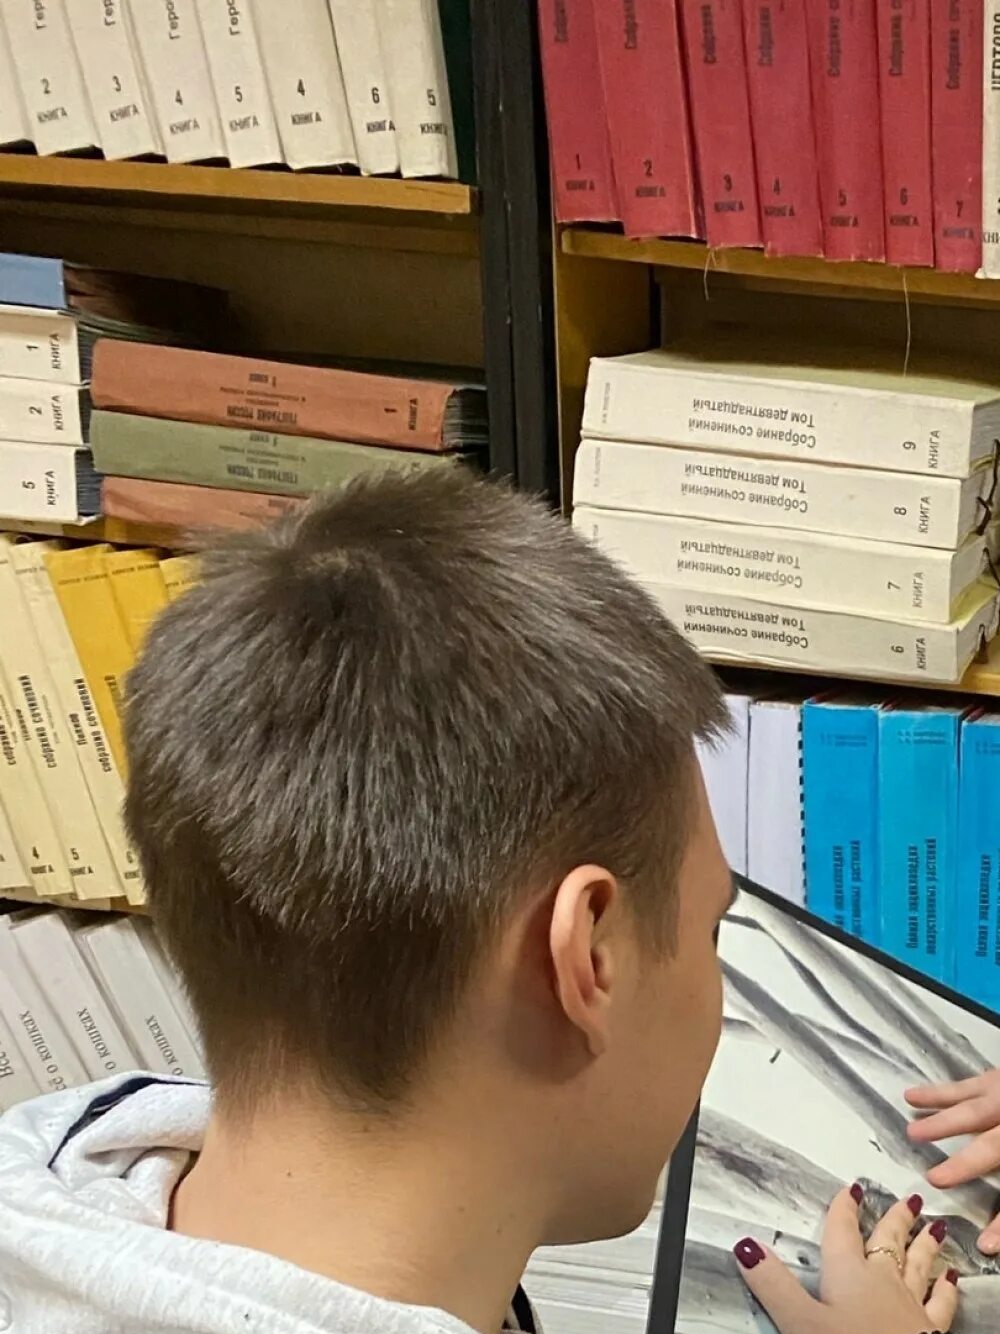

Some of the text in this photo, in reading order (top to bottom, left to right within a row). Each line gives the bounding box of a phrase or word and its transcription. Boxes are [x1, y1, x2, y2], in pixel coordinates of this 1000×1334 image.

[41, 78, 51, 94] 2
[112, 75, 122, 92] 3
[297, 79, 306, 96] 4
[175, 90, 183, 105] 4
[235, 86, 243, 103] 5
[371, 87, 380, 104] 6
[426, 89, 437, 106] 5
[37, 107, 68, 124] КНИГА
[109, 104, 140, 123] КНИГА
[291, 112, 322, 126] КНИГА
[169, 118, 200, 135] КНИГА
[229, 115, 259, 132] КНИГА
[366, 120, 396, 134] КНИГА
[575, 153, 581, 171] 1
[643, 159, 653, 177] 2
[564, 179, 596, 192] КНИГА
[634, 185, 667, 198] КНИГА
[723, 174, 733, 192] 3
[773, 178, 781, 196] 4
[838, 189, 847, 207] 5
[900, 188, 908, 206] 6
[714, 200, 744, 213] КНИГА
[763, 204, 795, 218] КНИГА
[956, 201, 964, 218] 7
[829, 214, 859, 228] КНИГА
[889, 214, 919, 228] КНИГА
[942, 226, 975, 240] КНИГА
[51, 333, 62, 370] КНИГА
[29, 406, 42, 415] 2
[52, 395, 64, 431] КНИГА
[693, 397, 815, 428] Том девятнадцатый
[689, 417, 816, 449] Собрание сочинений
[902, 440, 917, 452] 9
[927, 429, 941, 469] КНИГА
[22, 481, 36, 489] 5
[684, 462, 807, 494] Том девятнадцатый
[47, 470, 60, 506] КНИГА
[681, 482, 808, 514] Собрание сочинений
[894, 506, 907, 516] 8
[918, 496, 931, 534] КНИГА
[680, 540, 801, 570] Том девятнадцатый
[677, 557, 803, 589] Собрание сочинений
[888, 581, 900, 591] 7
[912, 571, 925, 609] КНИГА
[685, 603, 807, 632] Том девятнадцатый
[684, 621, 809, 649] Собрание сочинений
[892, 645, 904, 654] 6
[916, 637, 926, 671] КНИГА
[32, 846, 40, 859] 4
[71, 848, 80, 861] 5
[19, 1010, 52, 1061] кошках
[77, 1007, 112, 1057] кошках
[145, 1014, 178, 1064] кошках
